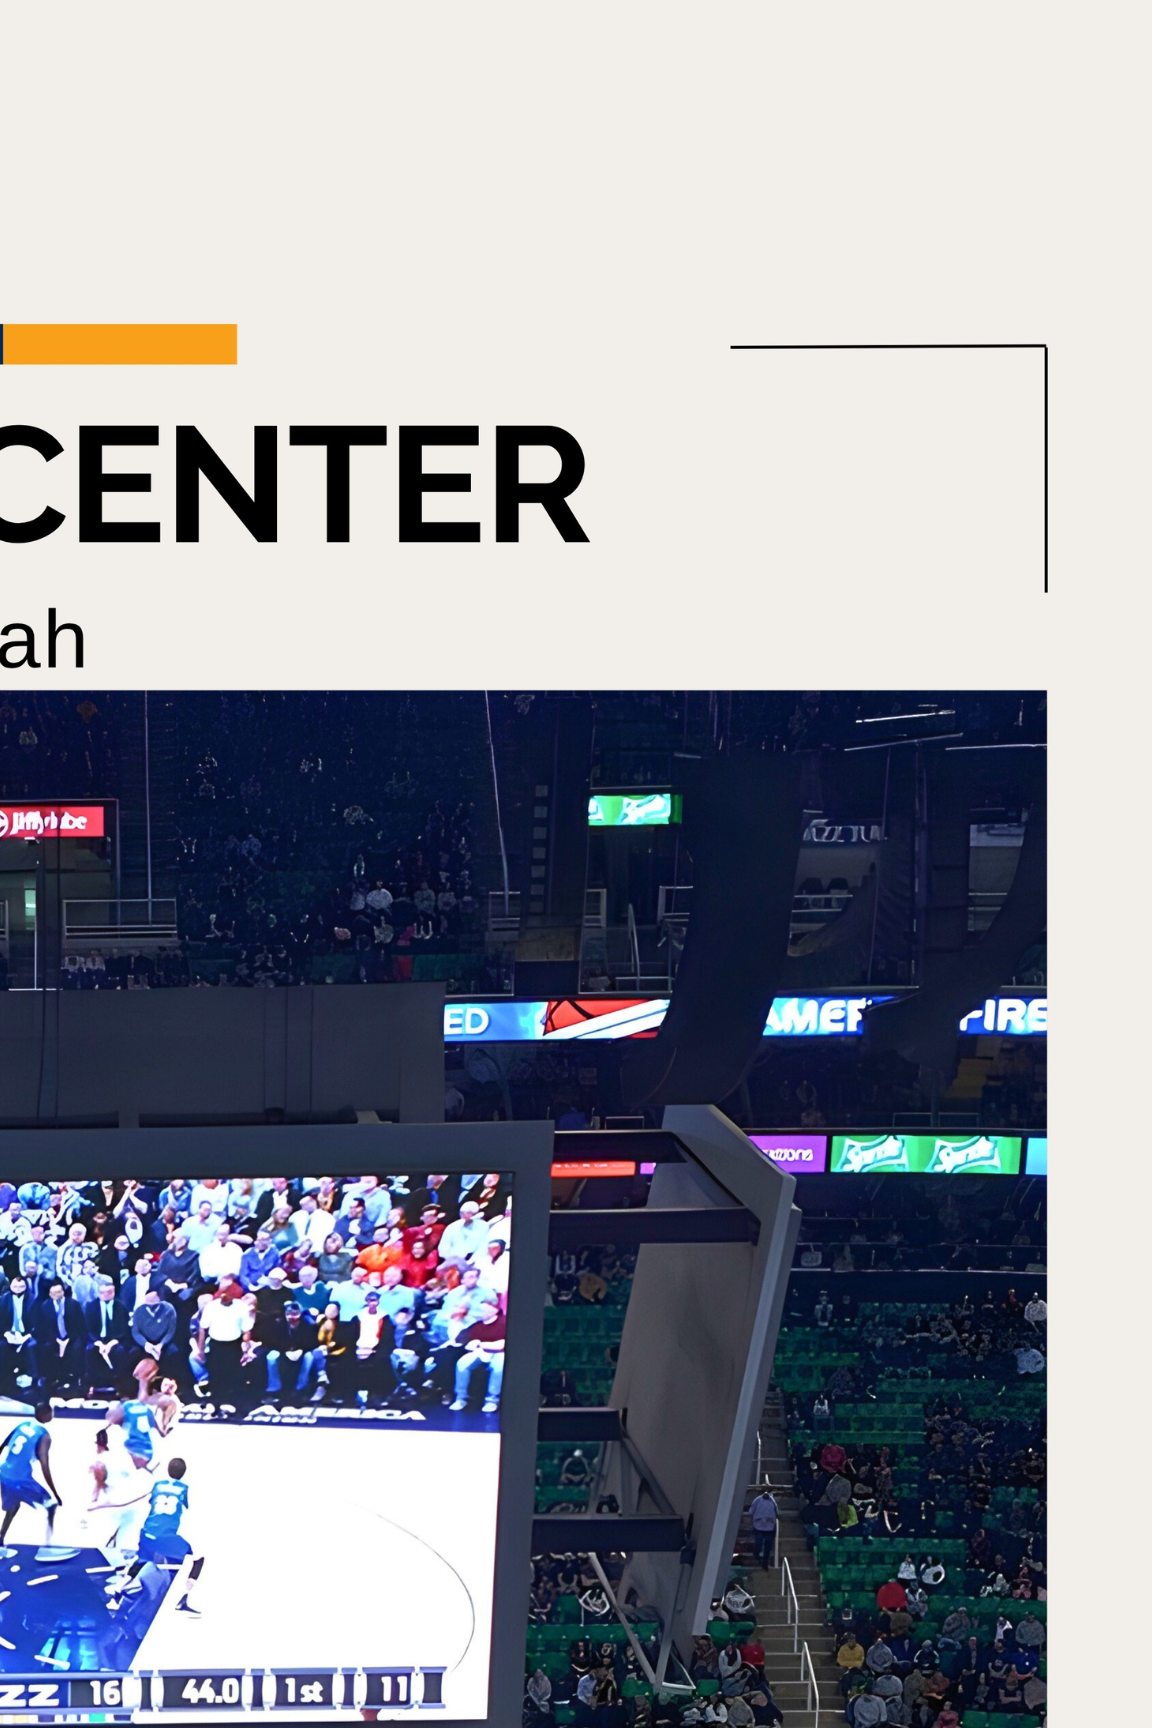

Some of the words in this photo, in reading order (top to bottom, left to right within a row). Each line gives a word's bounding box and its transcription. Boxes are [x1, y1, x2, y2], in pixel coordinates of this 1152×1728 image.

[90, 1680, 121, 1706] 16
[181, 1678, 240, 1703] 44.0
[381, 1676, 408, 1702] 11
